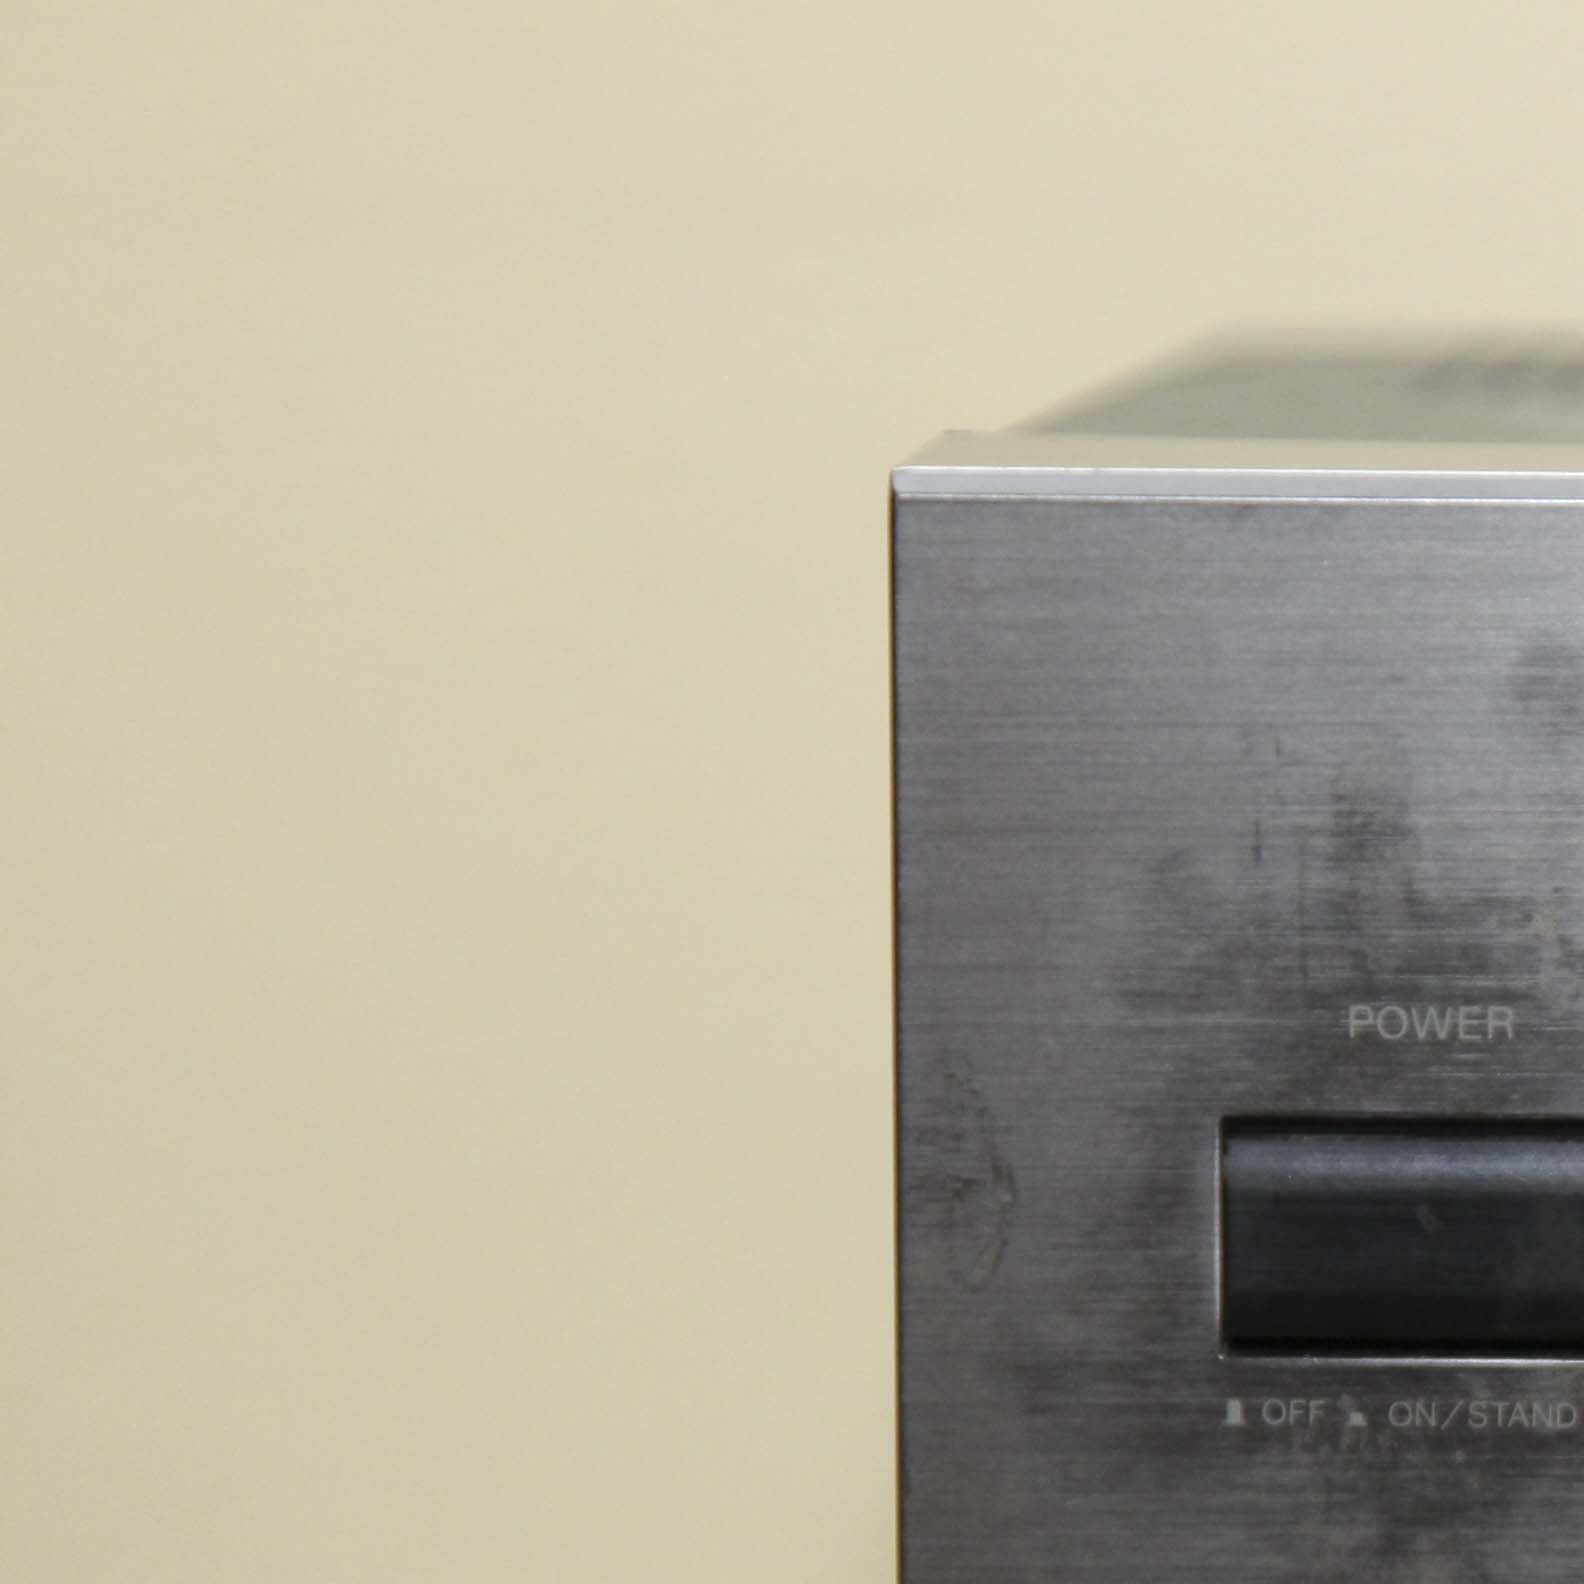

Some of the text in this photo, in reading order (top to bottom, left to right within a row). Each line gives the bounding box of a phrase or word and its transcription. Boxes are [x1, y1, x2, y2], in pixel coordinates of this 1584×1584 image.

[1346, 1003, 1516, 1043] POWER
[1262, 1402, 1329, 1428] OFF
[1387, 1401, 1578, 1430] ON/STAND
